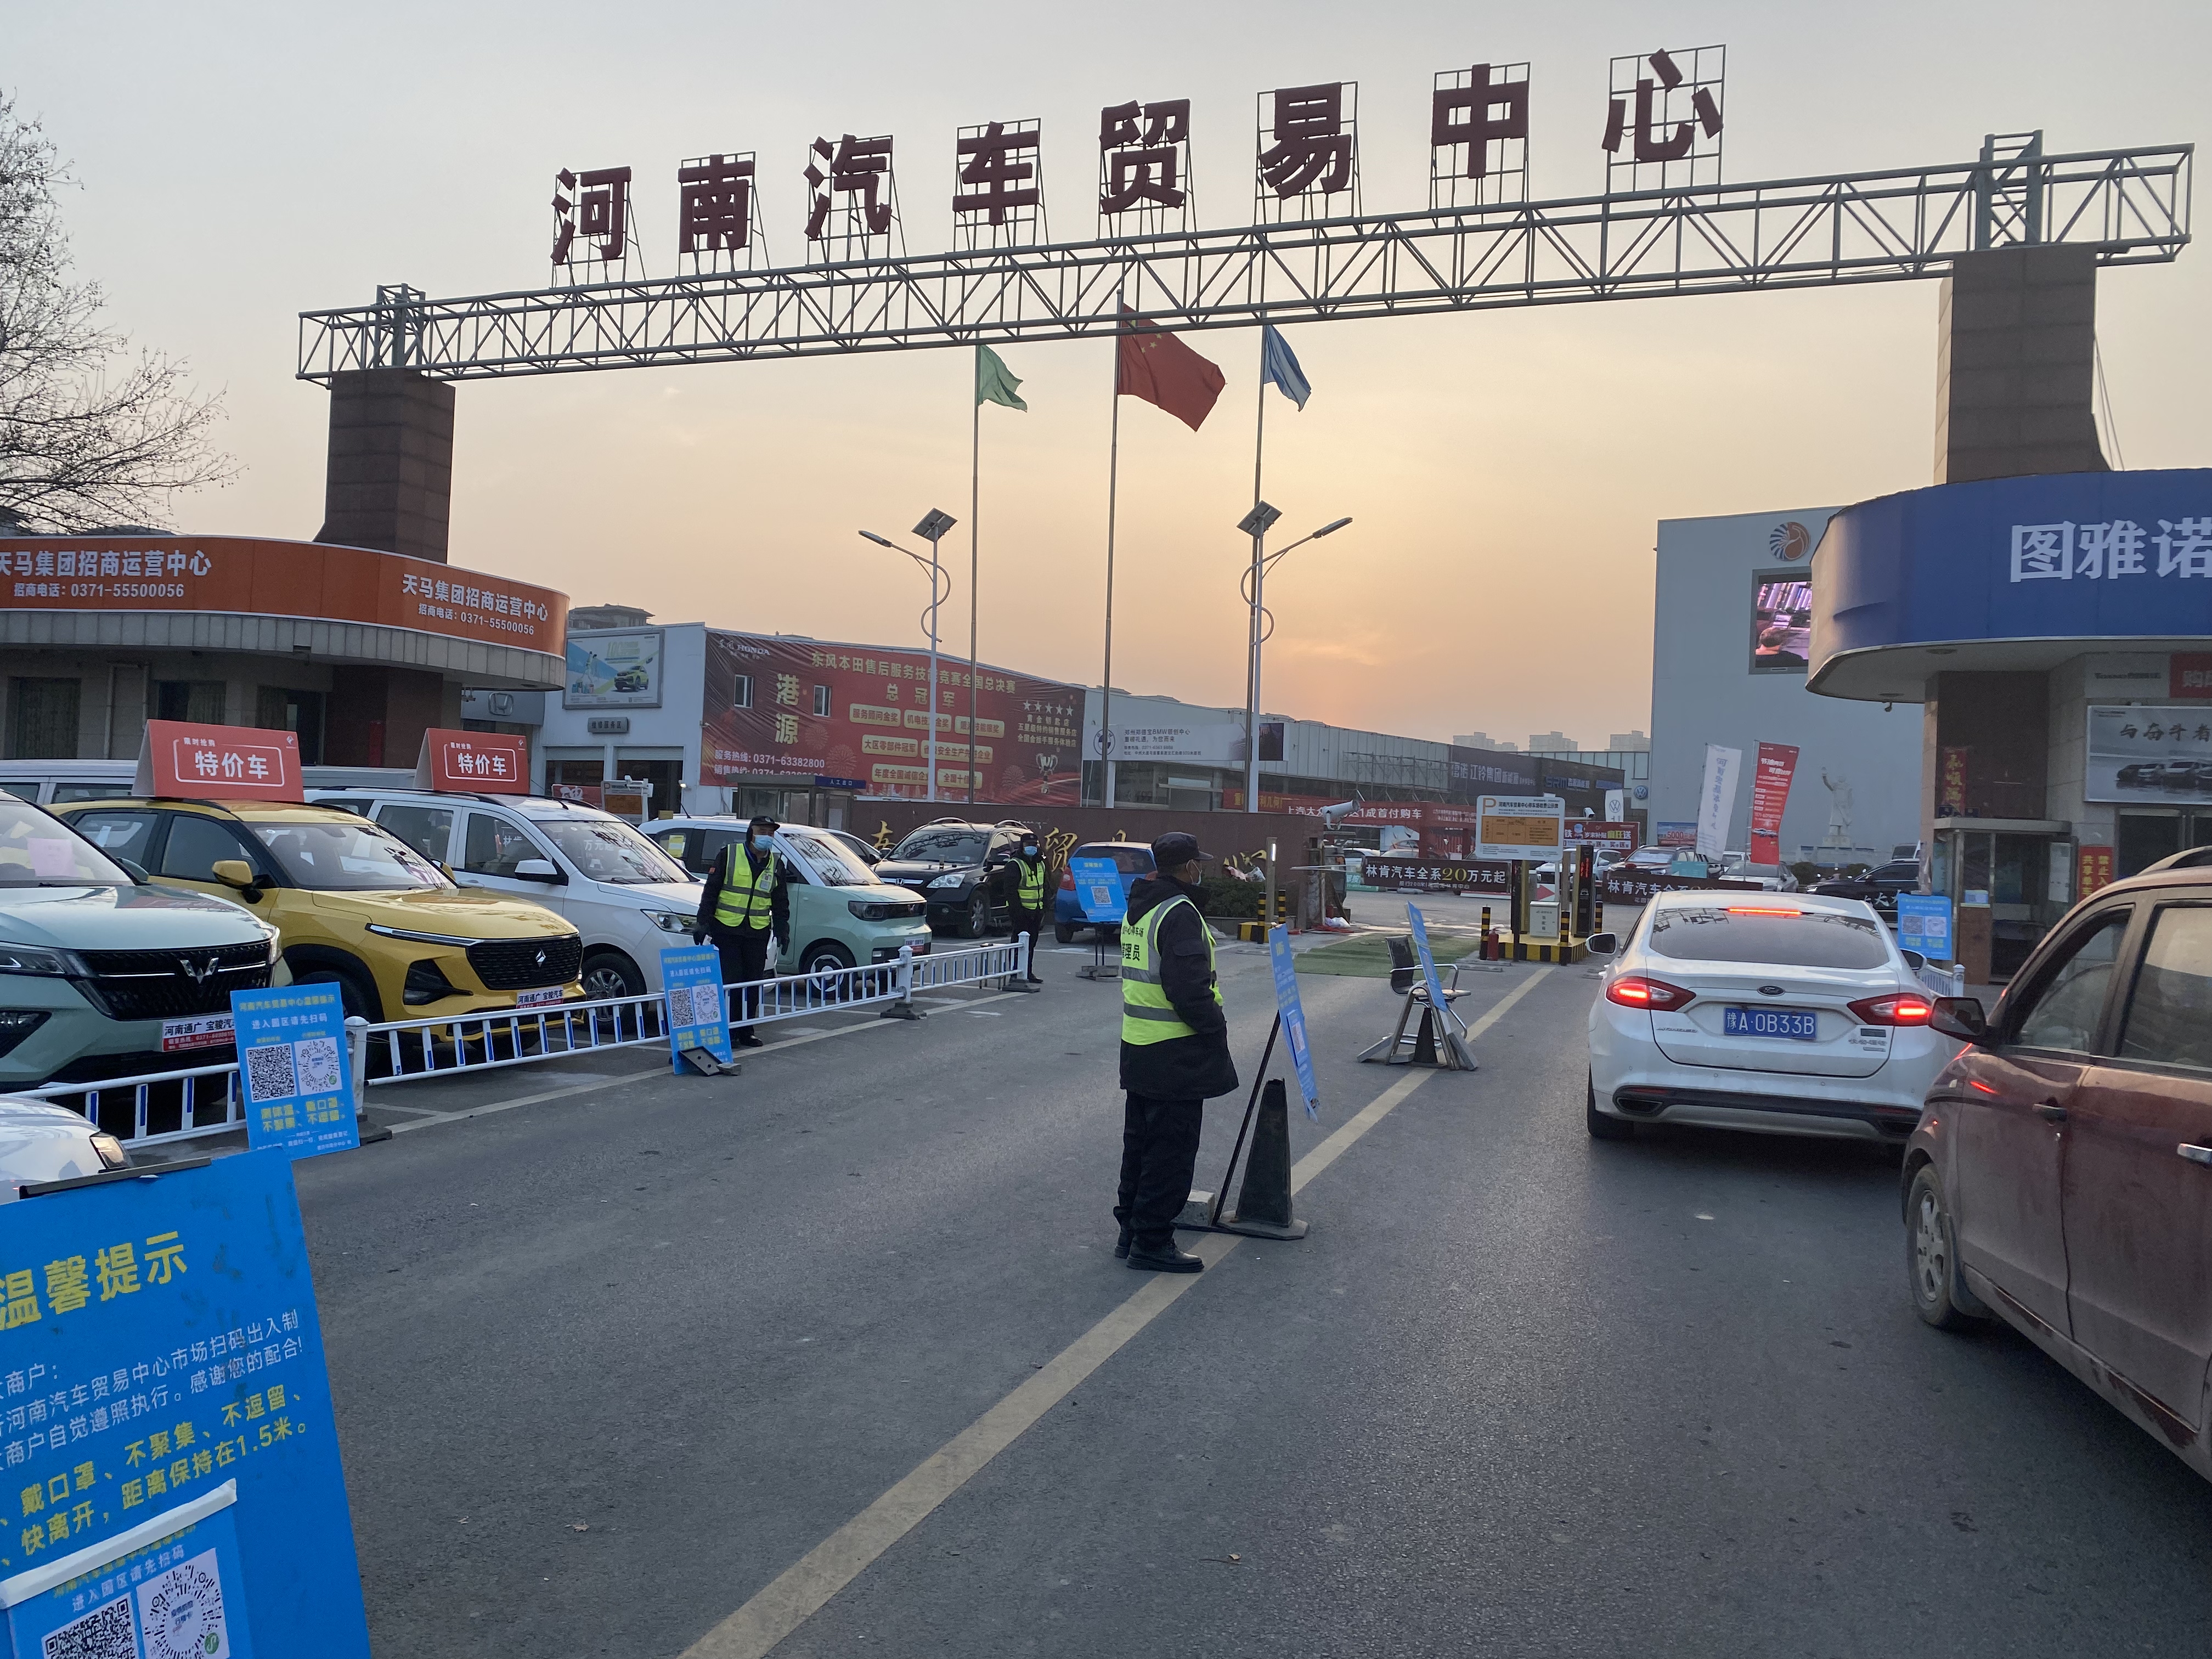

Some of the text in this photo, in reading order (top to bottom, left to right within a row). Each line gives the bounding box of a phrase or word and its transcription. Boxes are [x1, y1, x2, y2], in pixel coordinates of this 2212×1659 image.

[550, 48, 1722, 265] 河南汽车贸易中心
[2010, 517, 2212, 583] 图雅诺
[403, 573, 548, 622] 天马集团招商运营中心
[737, 644, 770, 656] HONDA
[885, 682, 956, 709] 总冠军
[775, 673, 799, 745] 港源
[853, 708, 898, 723] 服务顾问金奖
[907, 714, 949, 728] 机电技金奖
[864, 740, 916, 753] 大区零部件冠军
[195, 750, 269, 779] 特价车
[458, 753, 506, 776] 特价车
[1482, 798, 1497, 814] P
[1366, 865, 1506, 883] 林肯汽车全系20万元起
[518, 992, 540, 1004] 河南通广
[165, 1022, 202, 1036] 河南通广
[252, 1013, 328, 1030] 进入园区请先扫码
[0, 1231, 187, 1330] 温馨提示
